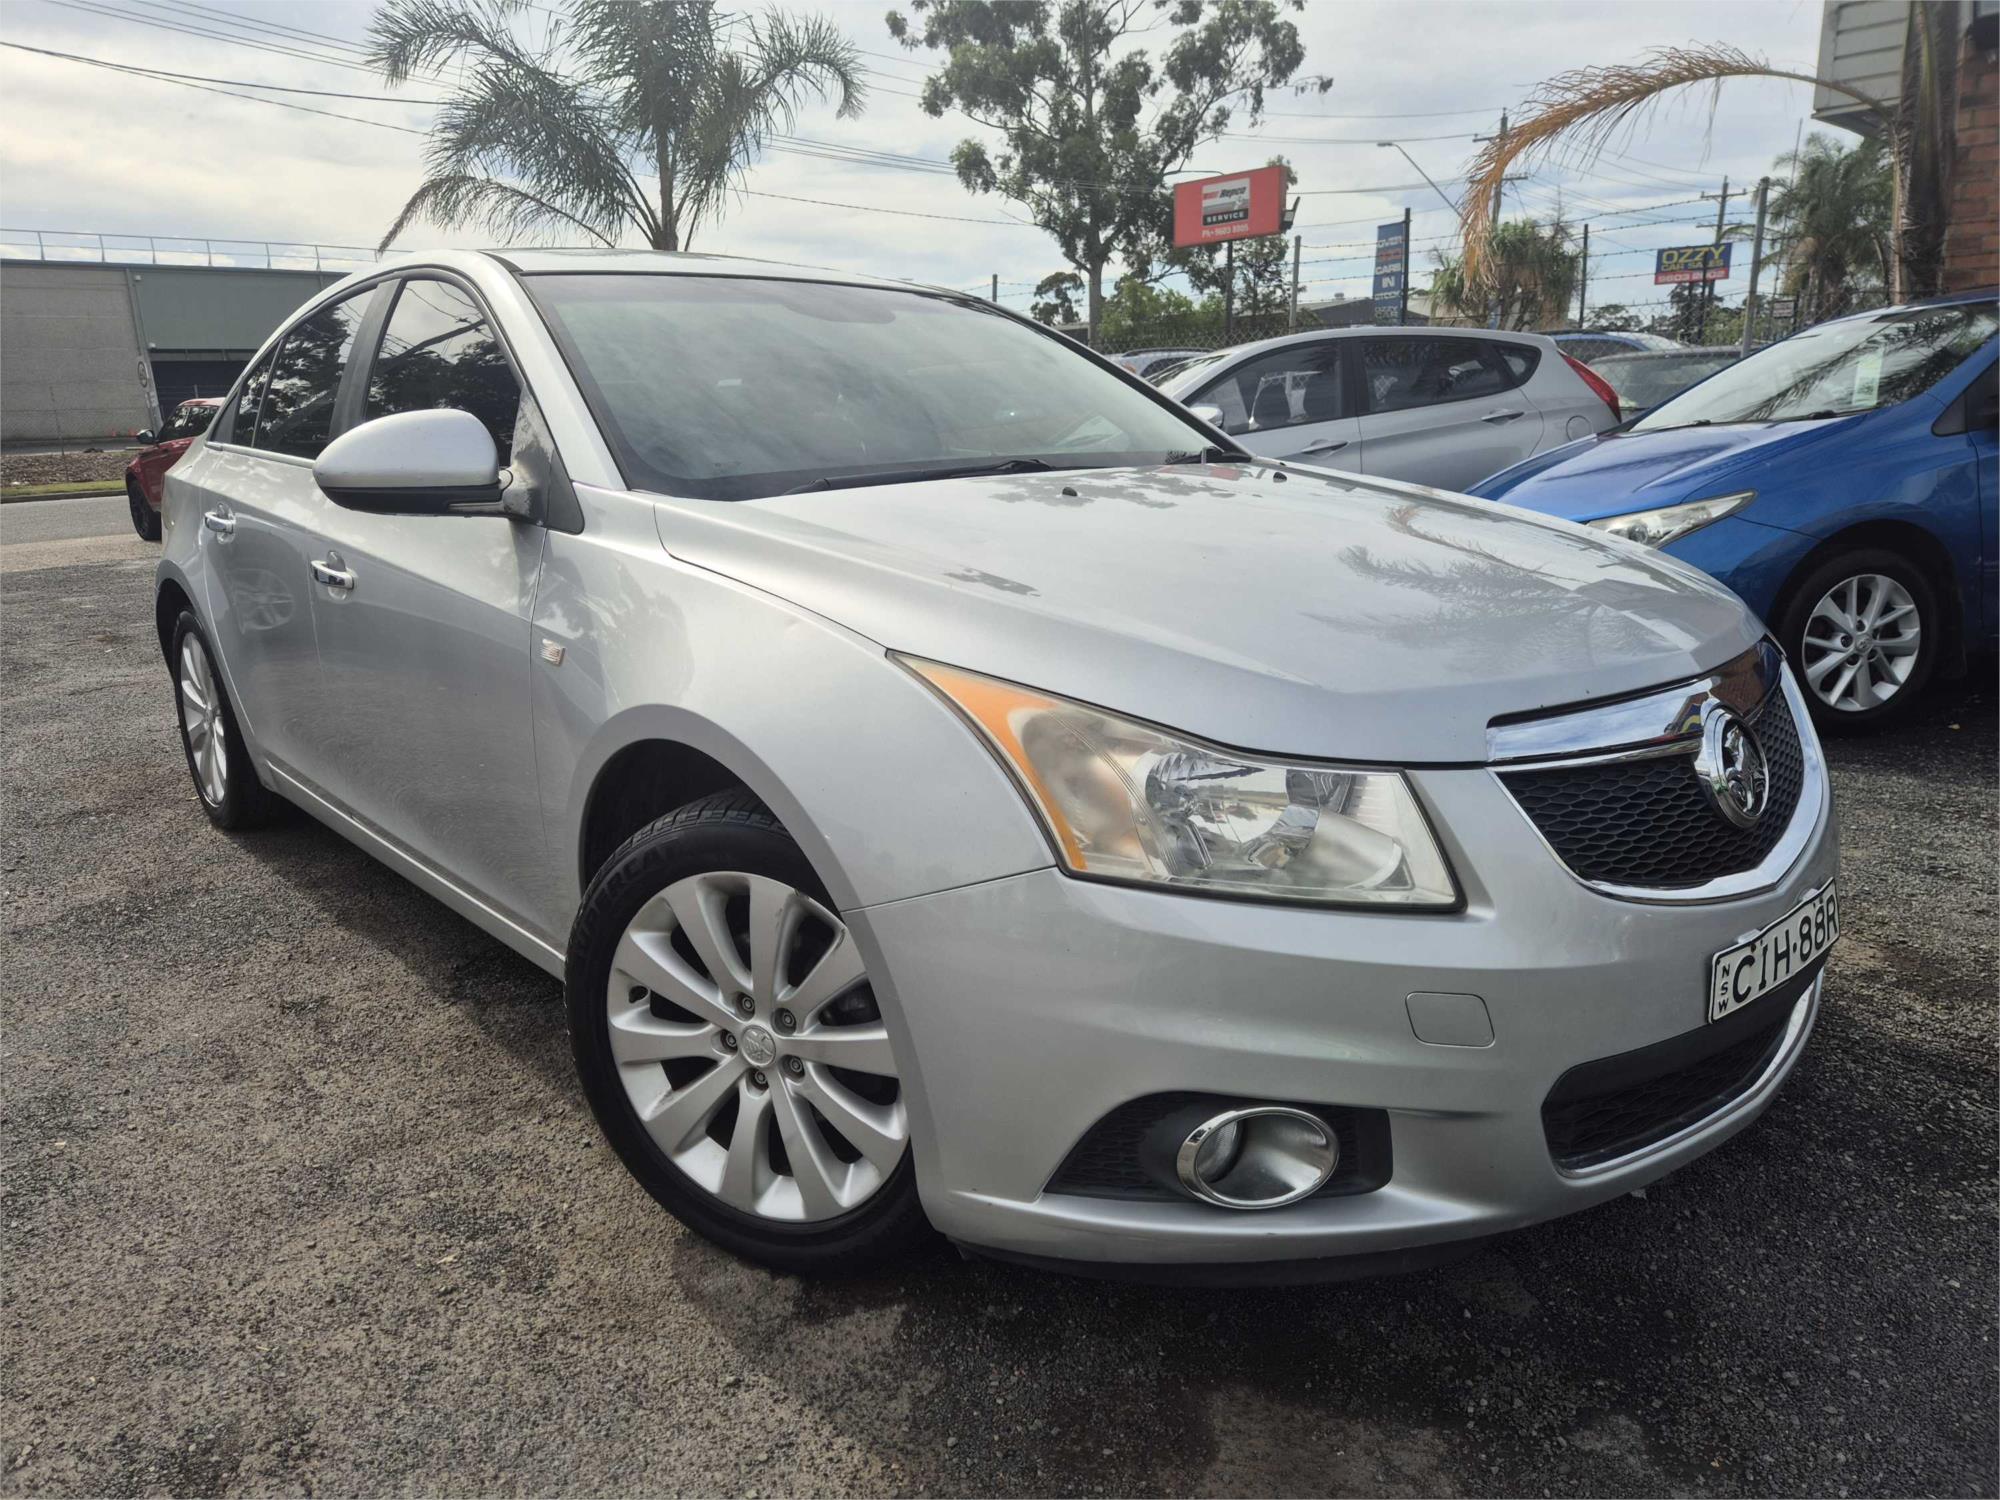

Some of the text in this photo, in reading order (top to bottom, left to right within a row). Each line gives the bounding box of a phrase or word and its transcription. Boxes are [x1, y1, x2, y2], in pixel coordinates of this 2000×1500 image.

[1206, 210, 1244, 223] SERVICE
[1663, 246, 1724, 264] OZZY
[1376, 263, 1401, 275] CARS
[1661, 263, 1683, 271] CAR
[1382, 275, 1395, 289] IN
[1718, 964, 1731, 1013] NSW
